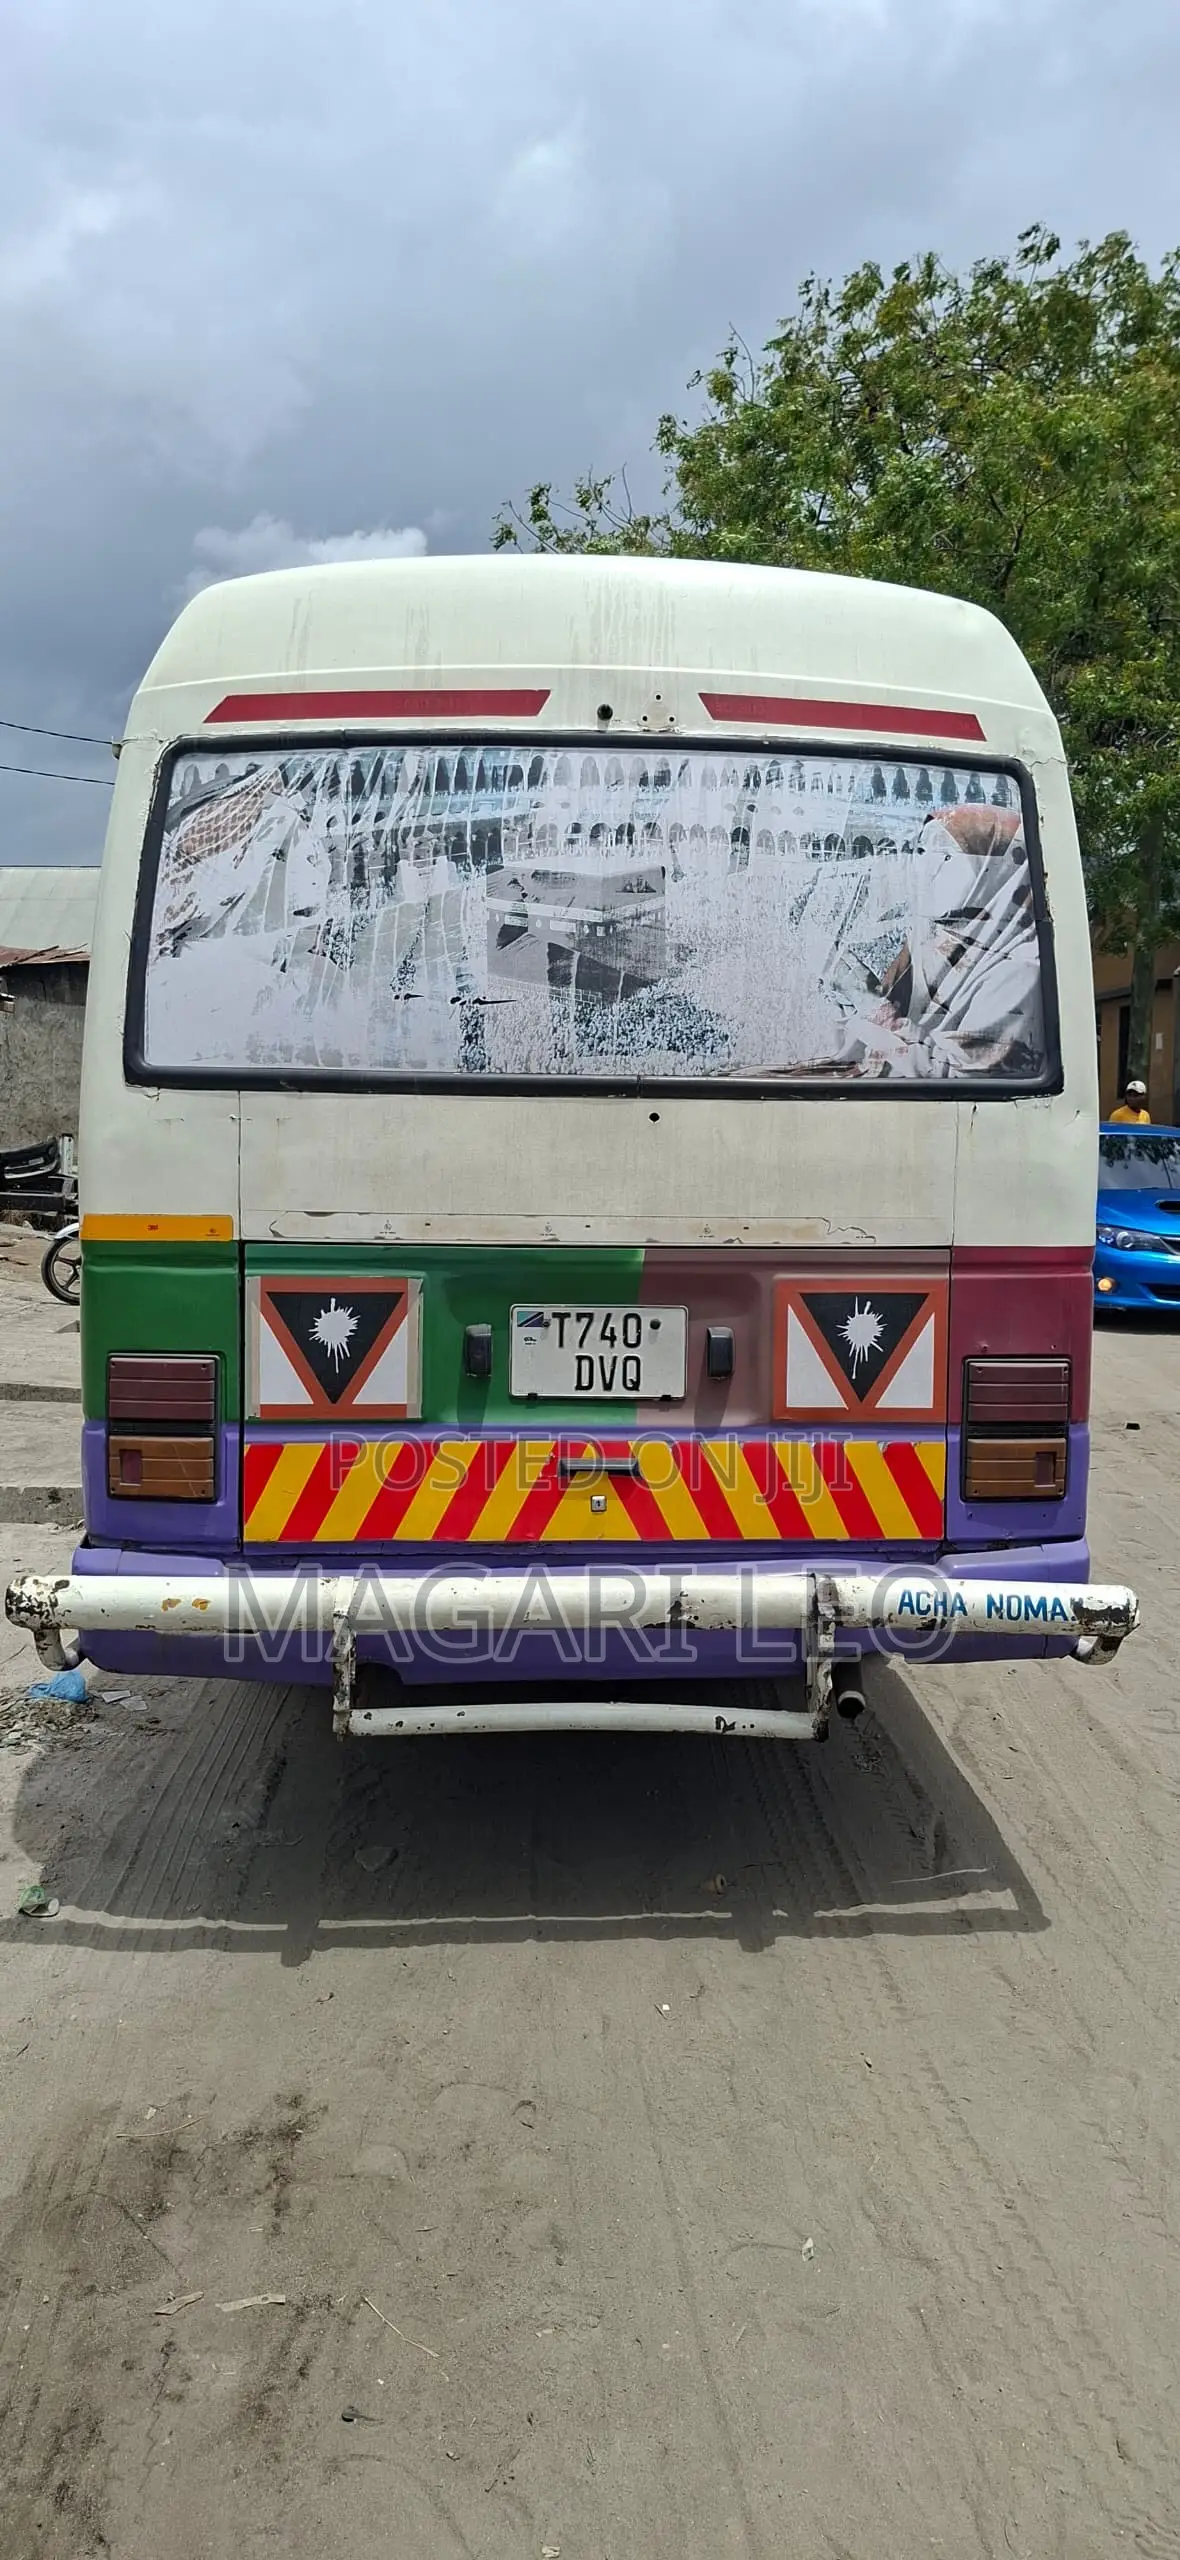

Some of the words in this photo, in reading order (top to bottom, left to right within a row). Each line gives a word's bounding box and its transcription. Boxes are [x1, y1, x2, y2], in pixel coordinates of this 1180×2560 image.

[552, 1312, 642, 1348] T740
[575, 1354, 641, 1391] DVQ
[897, 1589, 968, 1618] ACHA
